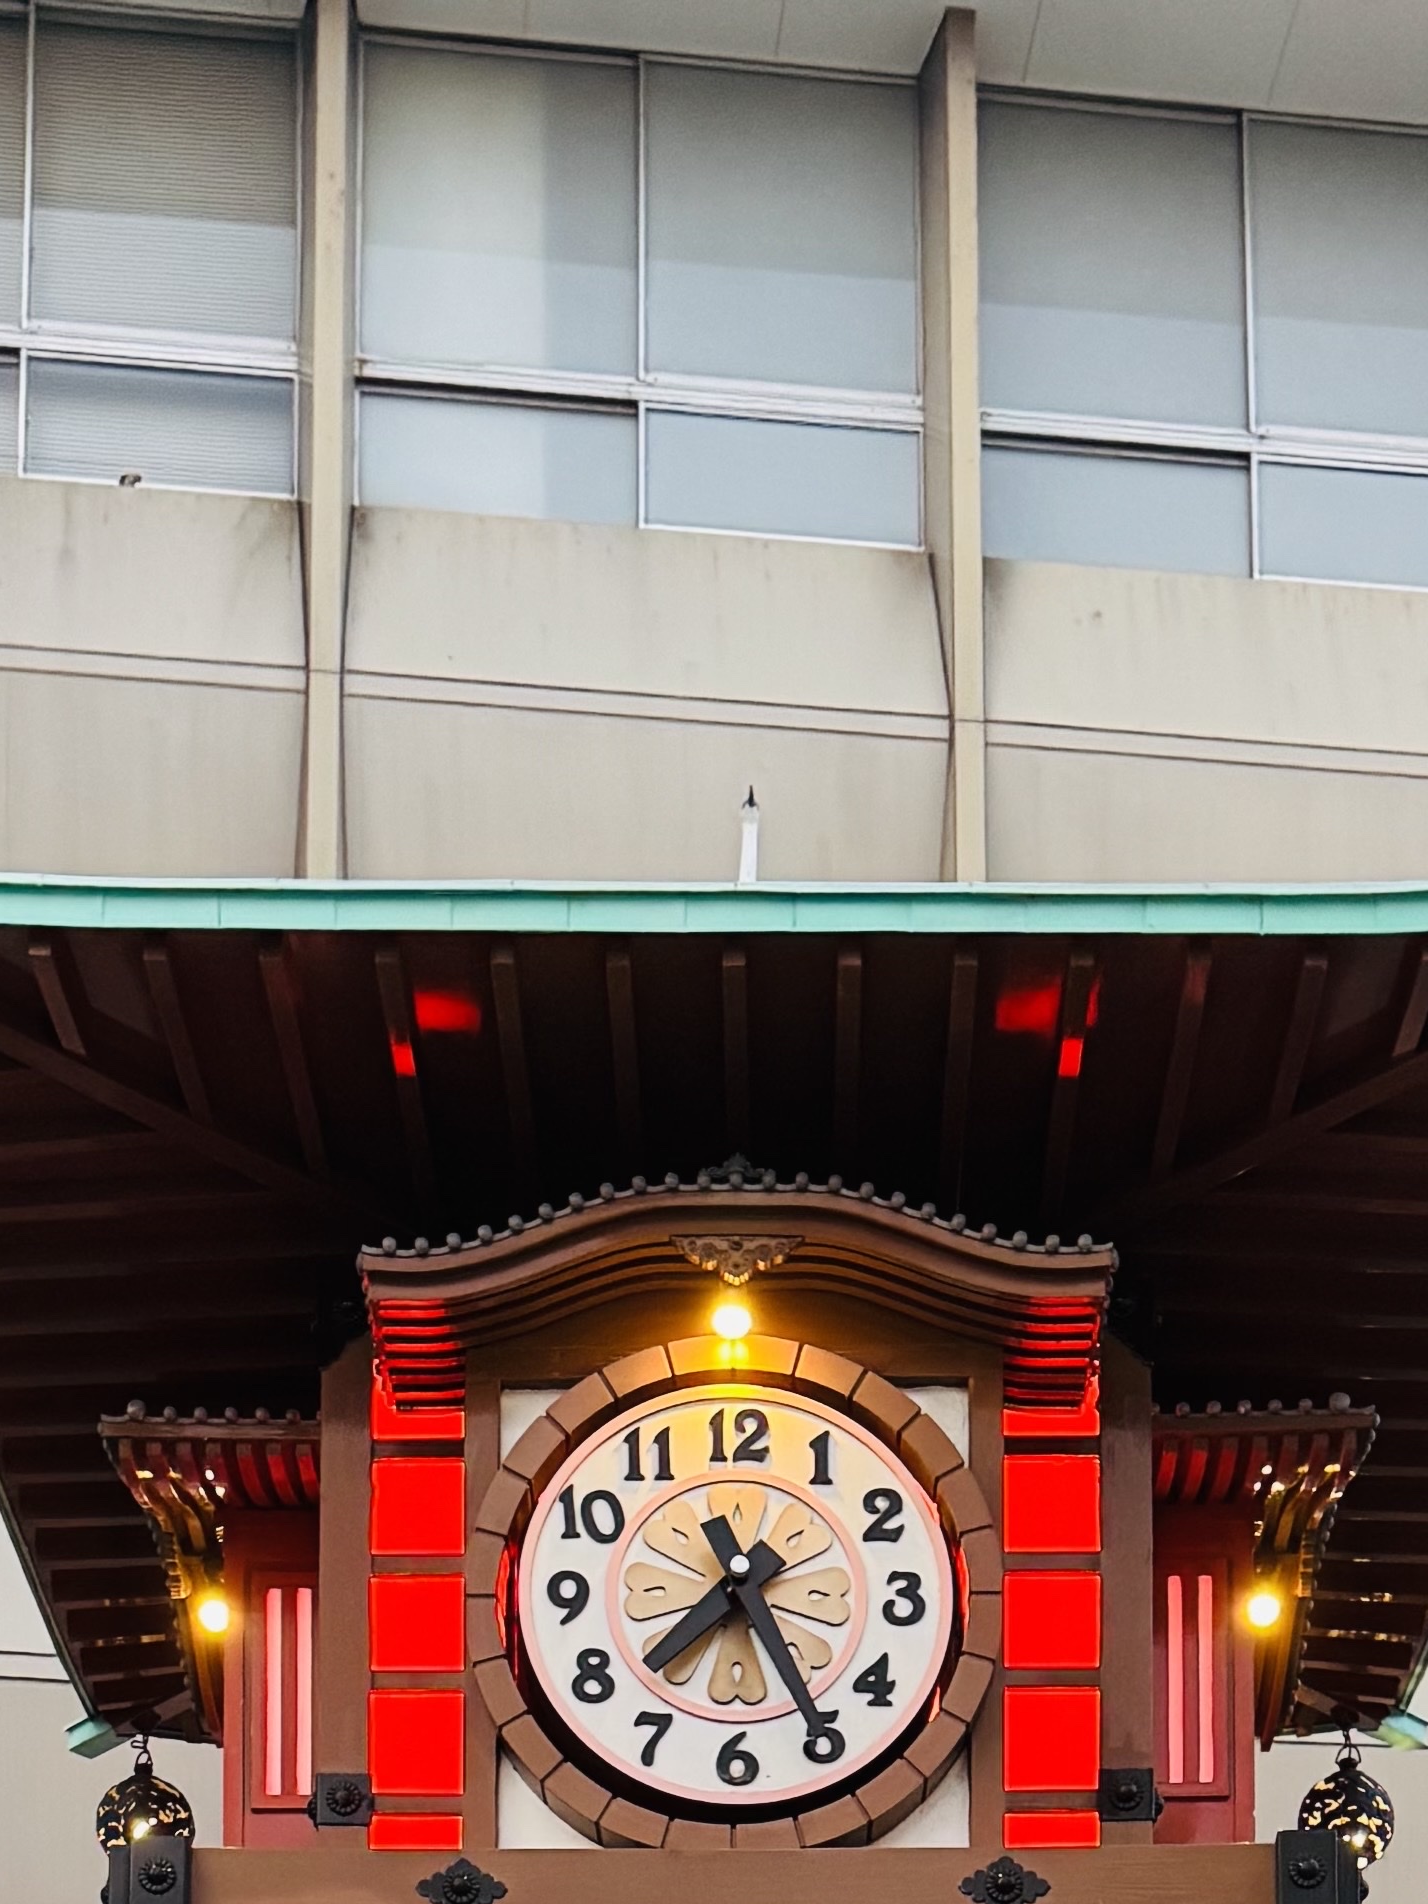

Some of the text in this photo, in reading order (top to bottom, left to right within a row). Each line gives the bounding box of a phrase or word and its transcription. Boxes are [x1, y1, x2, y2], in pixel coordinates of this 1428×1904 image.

[624, 1426, 675, 1481] 11
[709, 1408, 770, 1463] 12
[809, 1431, 833, 1485] 1
[558, 1484, 625, 1544] 10
[862, 1488, 905, 1543] 2
[547, 1570, 590, 1626] 9
[882, 1571, 926, 1626] 3
[572, 1648, 615, 1704] 8
[853, 1652, 896, 1707] 4
[634, 1711, 673, 1767] 7
[716, 1731, 759, 1786] 6
[803, 1710, 846, 1763] 5
